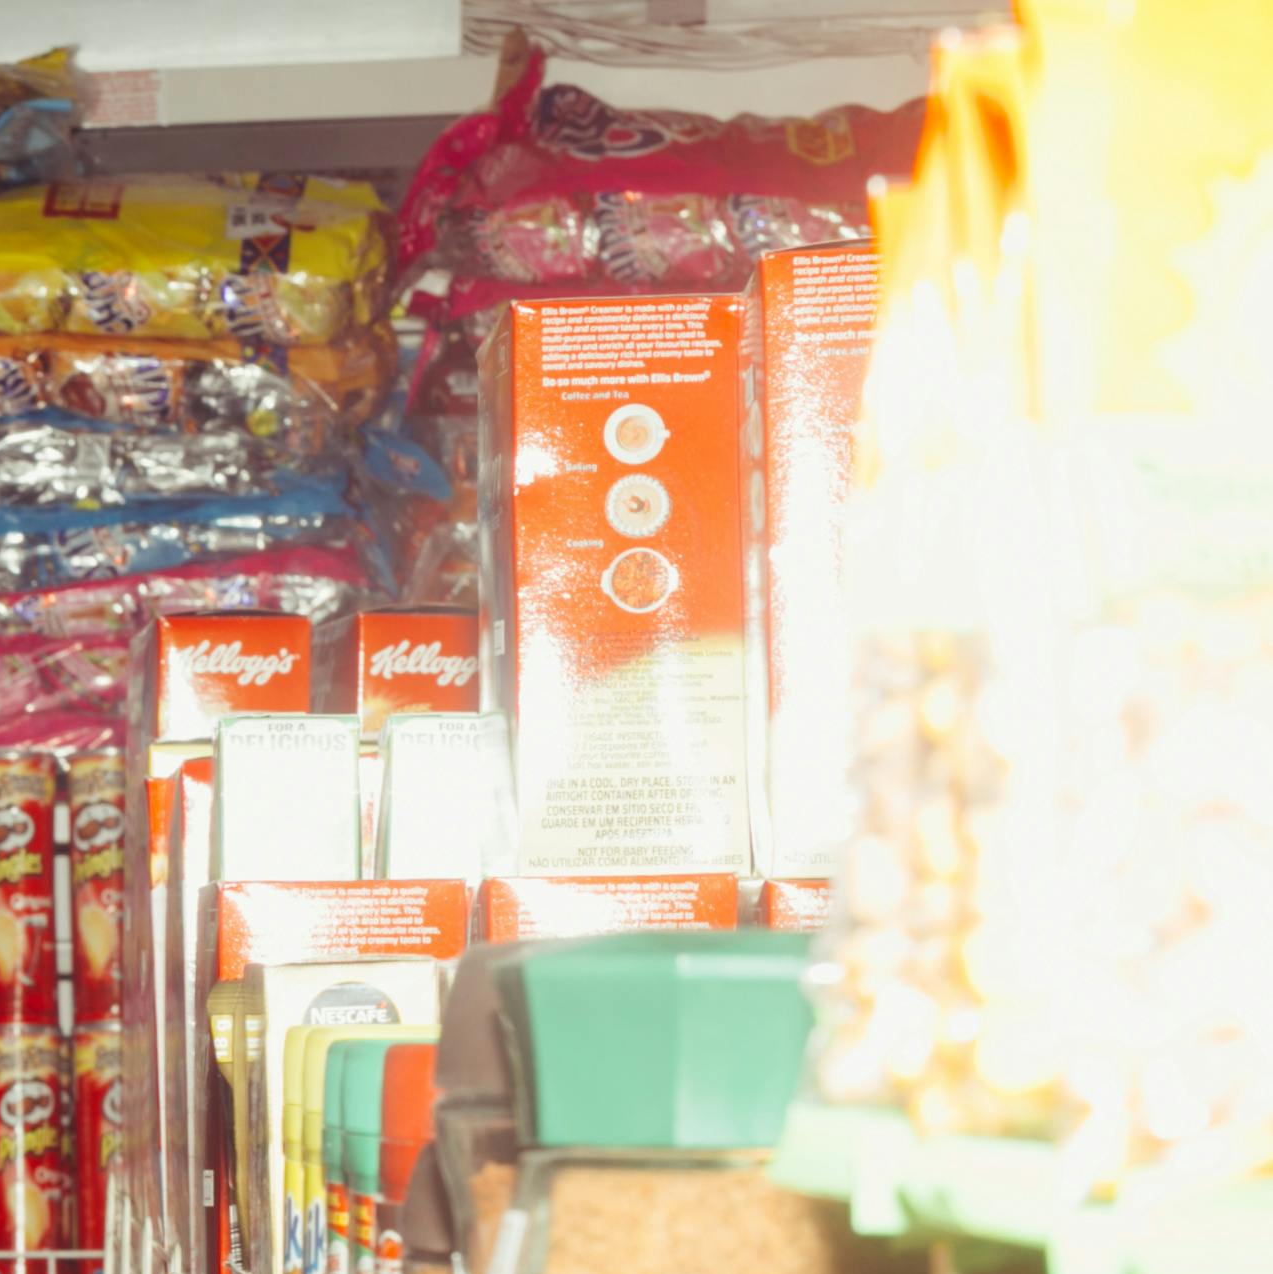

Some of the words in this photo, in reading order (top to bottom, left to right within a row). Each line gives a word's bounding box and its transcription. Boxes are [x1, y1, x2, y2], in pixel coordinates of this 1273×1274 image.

[542, 377, 556, 387] Do
[557, 377, 569, 386] so
[571, 375, 598, 386] much
[600, 376, 625, 385] more
[627, 373, 648, 383] with
[650, 373, 671, 383] Ellis
[561, 391, 590, 400] Coffee
[593, 391, 611, 400] and
[613, 390, 629, 399] Tea
[567, 538, 604, 548] Cooking
[176, 639, 294, 686] Kellogg's
[267, 723, 298, 732] FOR
[299, 723, 307, 732] A
[228, 732, 347, 750] DELICIOUS
[591, 789, 645, 800] CONTAINER
[647, 788, 677, 799] AFTER
[623, 846, 647, 856] BABY
[552, 858, 595, 868] UTILIZAR
[598, 857, 627, 866] COMO
